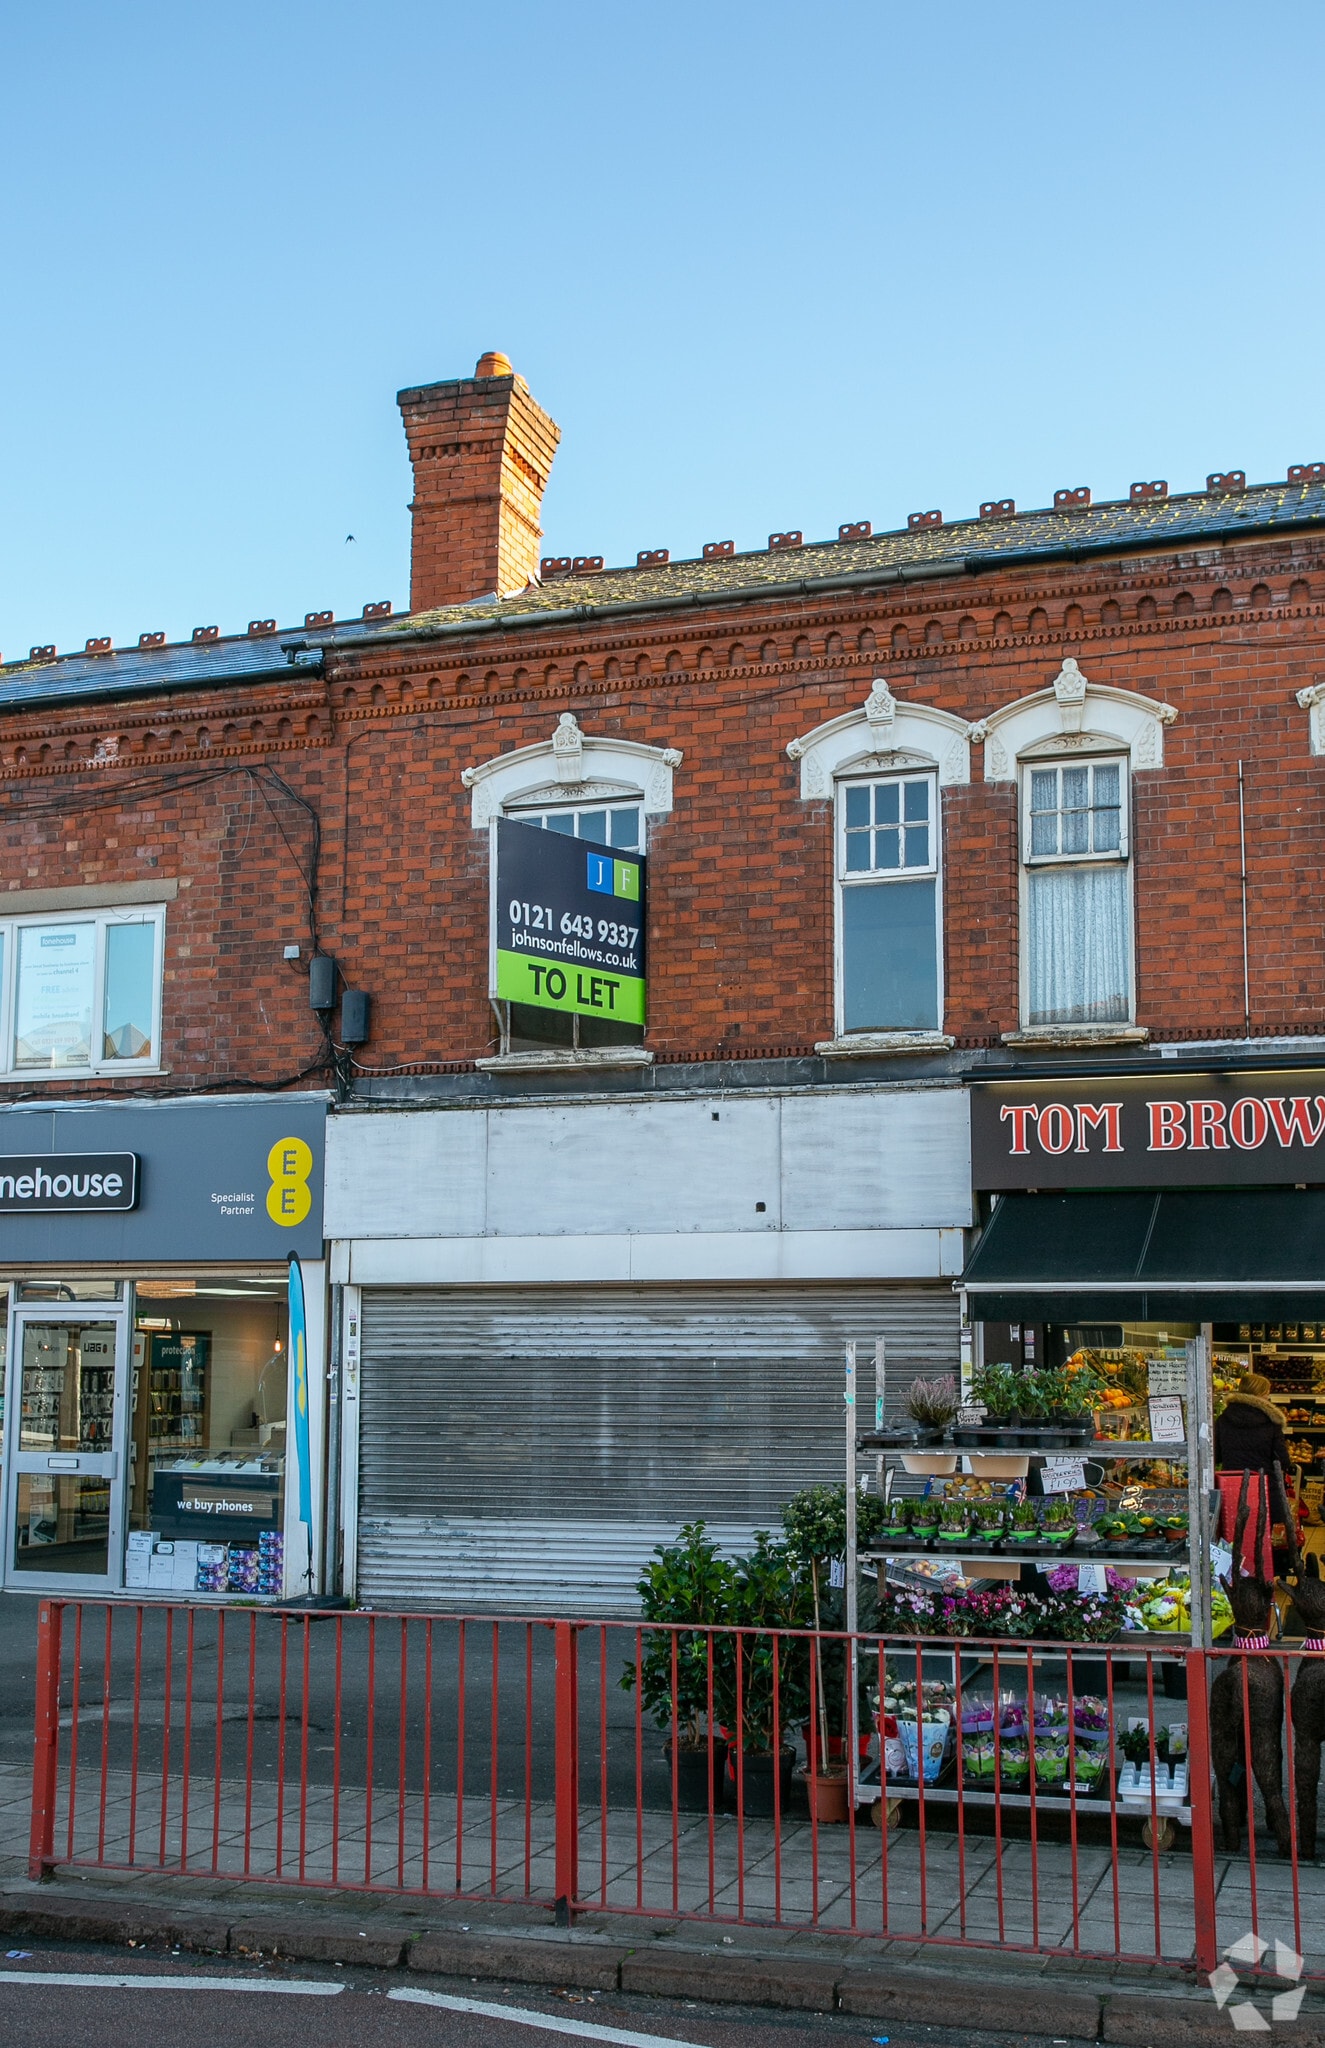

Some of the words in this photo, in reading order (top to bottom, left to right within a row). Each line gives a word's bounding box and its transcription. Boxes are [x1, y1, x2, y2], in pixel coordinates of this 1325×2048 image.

[596, 861, 604, 886] J
[622, 868, 631, 892] F
[509, 899, 553, 931] 0121
[560, 912, 593, 940] 643
[598, 919, 639, 949] 9337
[511, 928, 637, 969] johnsonfellows.co.uk
[41, 986, 60, 994] FREE
[528, 964, 566, 1000] TO
[577, 974, 620, 1010] LET
[1000, 1102, 1125, 1155] TOM
[211, 1192, 255, 1204] Specialist
[221, 1204, 255, 1215] Partner
[177, 1501, 193, 1511] we
[194, 1498, 214, 1513] buy
[215, 1498, 253, 1513] phones
